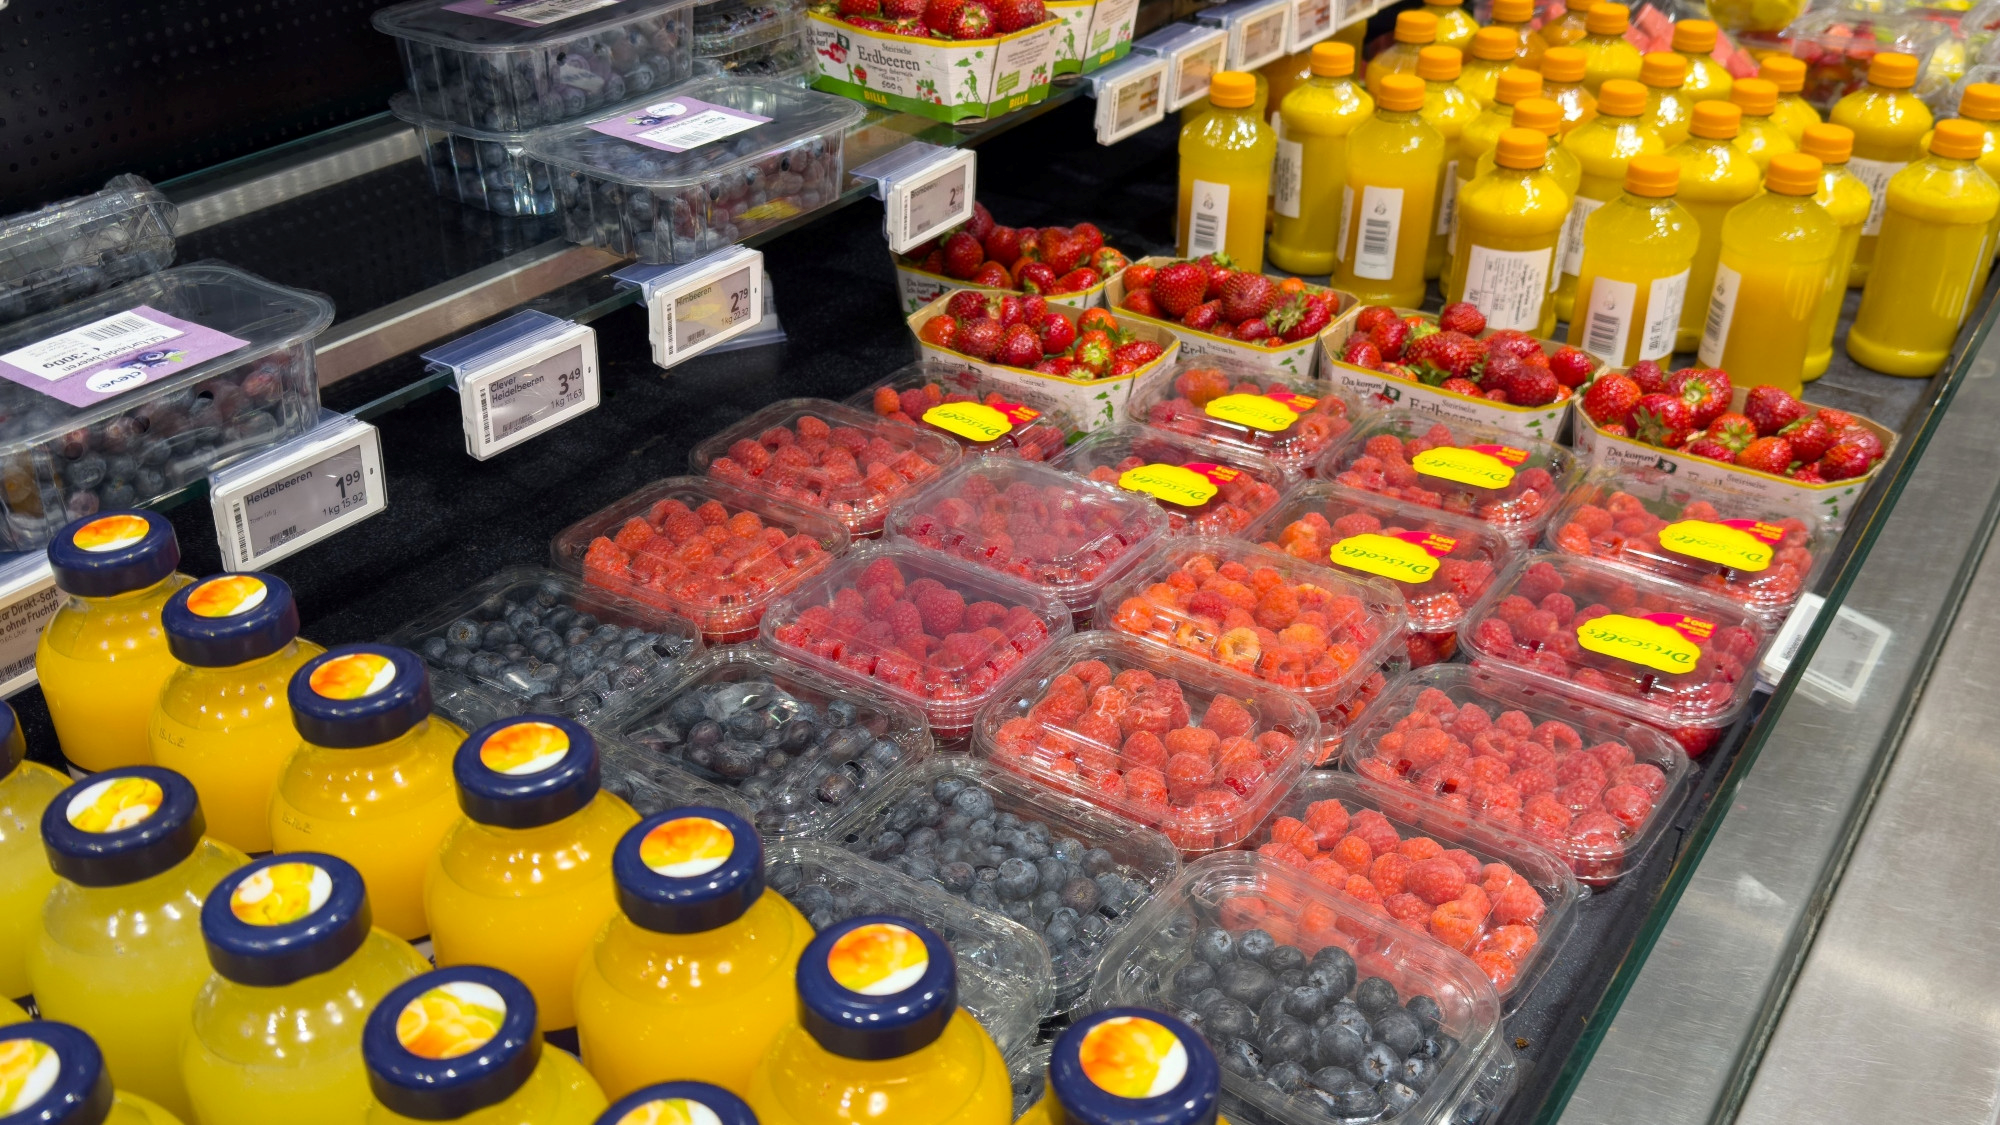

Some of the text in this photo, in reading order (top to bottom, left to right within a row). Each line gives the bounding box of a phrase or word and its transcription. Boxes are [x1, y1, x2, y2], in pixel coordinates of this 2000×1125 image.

[856, 44, 921, 72] Erdbeeren
[881, 42, 912, 56] Steirische
[863, 89, 888, 105] BILLA
[881, 80, 903, 96] 500 g
[1008, 93, 1029, 109] BILLA
[676, 286, 712, 308] Himbeeren
[730, 287, 749, 313] 279
[725, 316, 733, 325] kg
[733, 307, 749, 321] 22.32
[97, 370, 143, 391] clever
[490, 376, 516, 393] Clever
[491, 375, 545, 404] Heidelbeeren
[558, 367, 581, 396] 349
[555, 398, 565, 408] kg
[565, 388, 583, 403] 11.63
[246, 470, 314, 507] Heidelbeeren
[335, 469, 361, 499] 199
[1725, 473, 1768, 491] Steirische
[328, 504, 341, 516] kg
[341, 491, 365, 509] 15.92
[11, 587, 59, 617] Direkt-Saft
[6, 617, 27, 632] ohne
